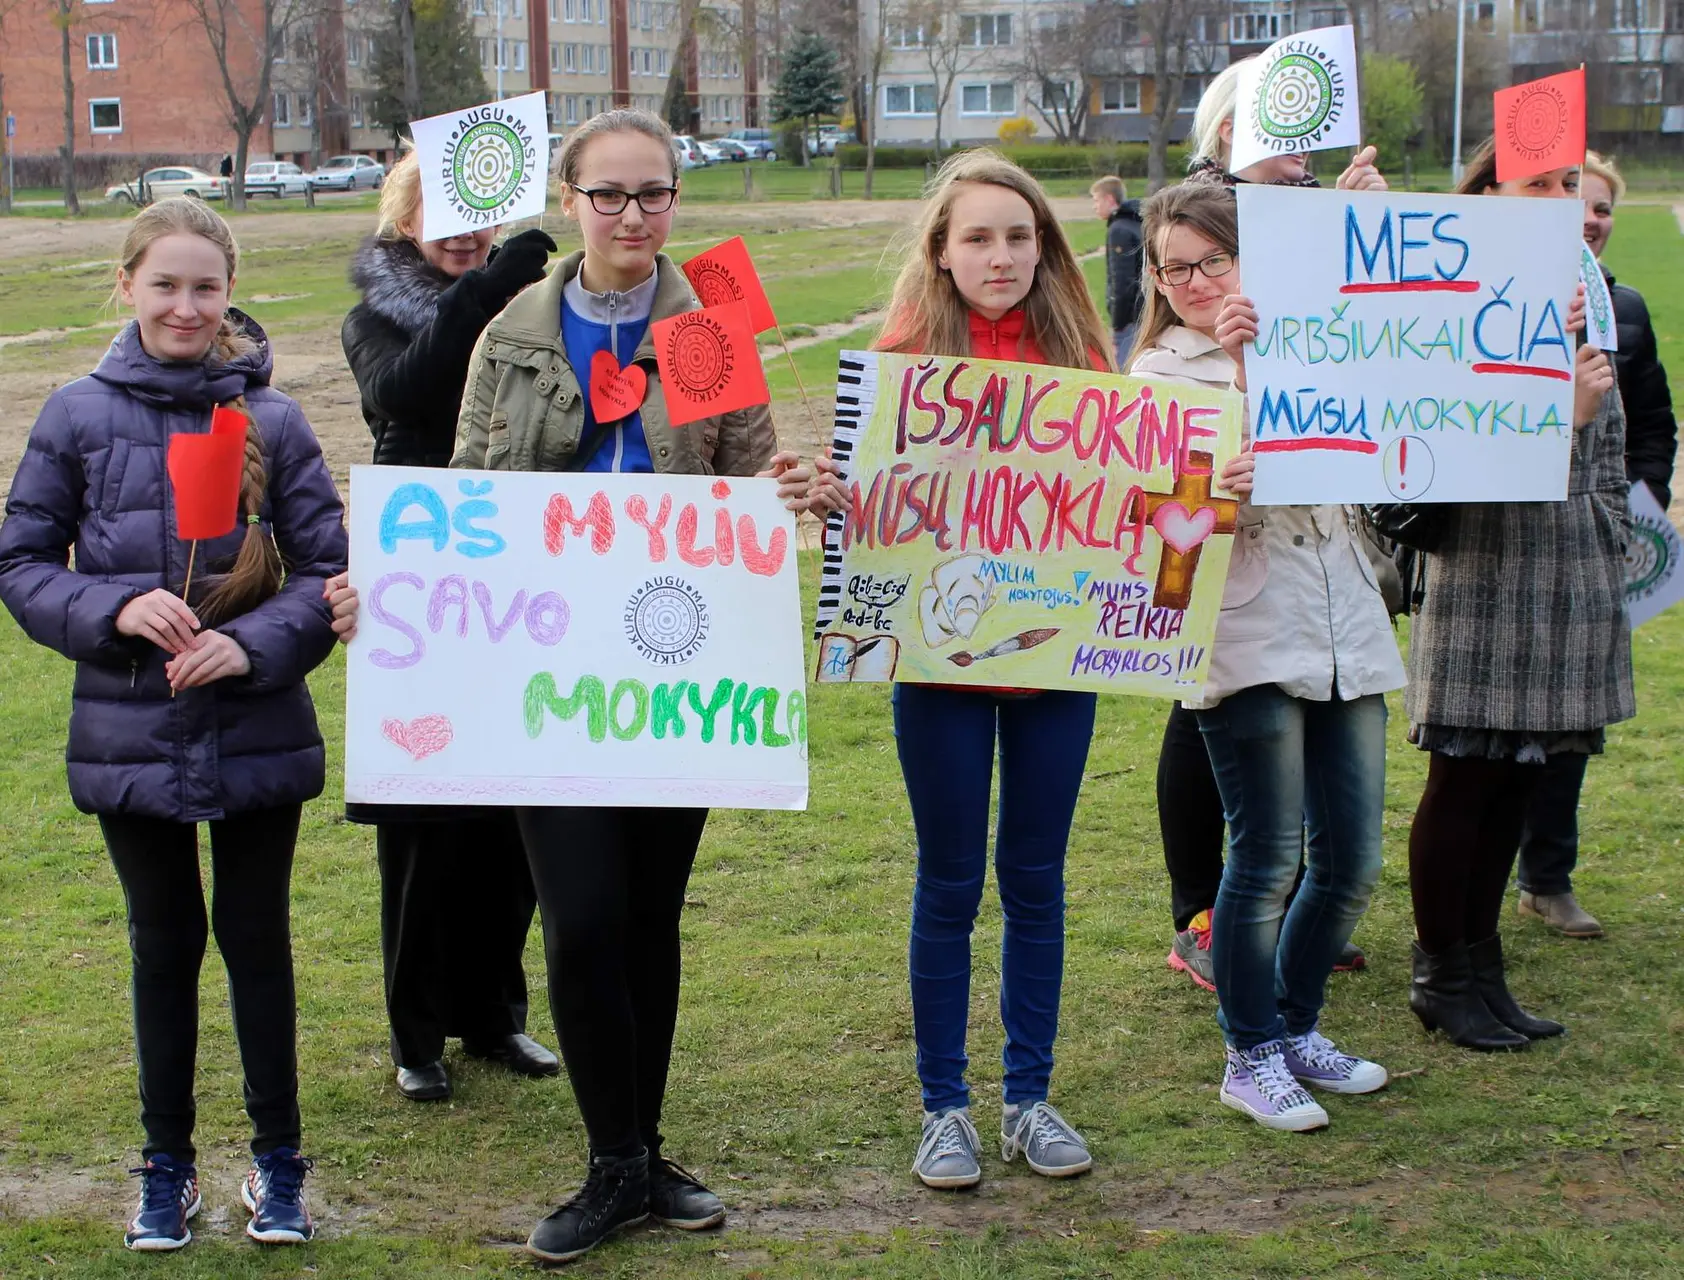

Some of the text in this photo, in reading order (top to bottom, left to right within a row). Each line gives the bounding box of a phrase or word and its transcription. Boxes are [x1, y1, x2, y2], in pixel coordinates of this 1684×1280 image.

[1324, 59, 1345, 123] KURIU
[458, 107, 504, 133] AUGU
[1271, 129, 1323, 151] AUGU
[442, 141, 459, 206] KURIU
[512, 119, 536, 203] MASTAU
[462, 205, 509, 224] TIKIU
[1344, 204, 1469, 283] MES
[674, 312, 704, 331] AUGU
[1473, 276, 1571, 365] ČIA
[667, 338, 680, 388] KURIU
[711, 322, 734, 385] MASTAU
[685, 388, 720, 403] TIKIU
[1255, 385, 1372, 440] MŪSŲ
[379, 479, 506, 558] AŠ
[645, 576, 684, 591] AUGU
[979, 560, 1035, 585] MYLIM
[1087, 580, 1149, 602] MUMS
[368, 571, 571, 669] SAVO
[624, 594, 639, 645] KURIU
[691, 590, 710, 652] MASTAU
[1096, 601, 1184, 641] REIKIA
[642, 649, 687, 664] TIKIU
